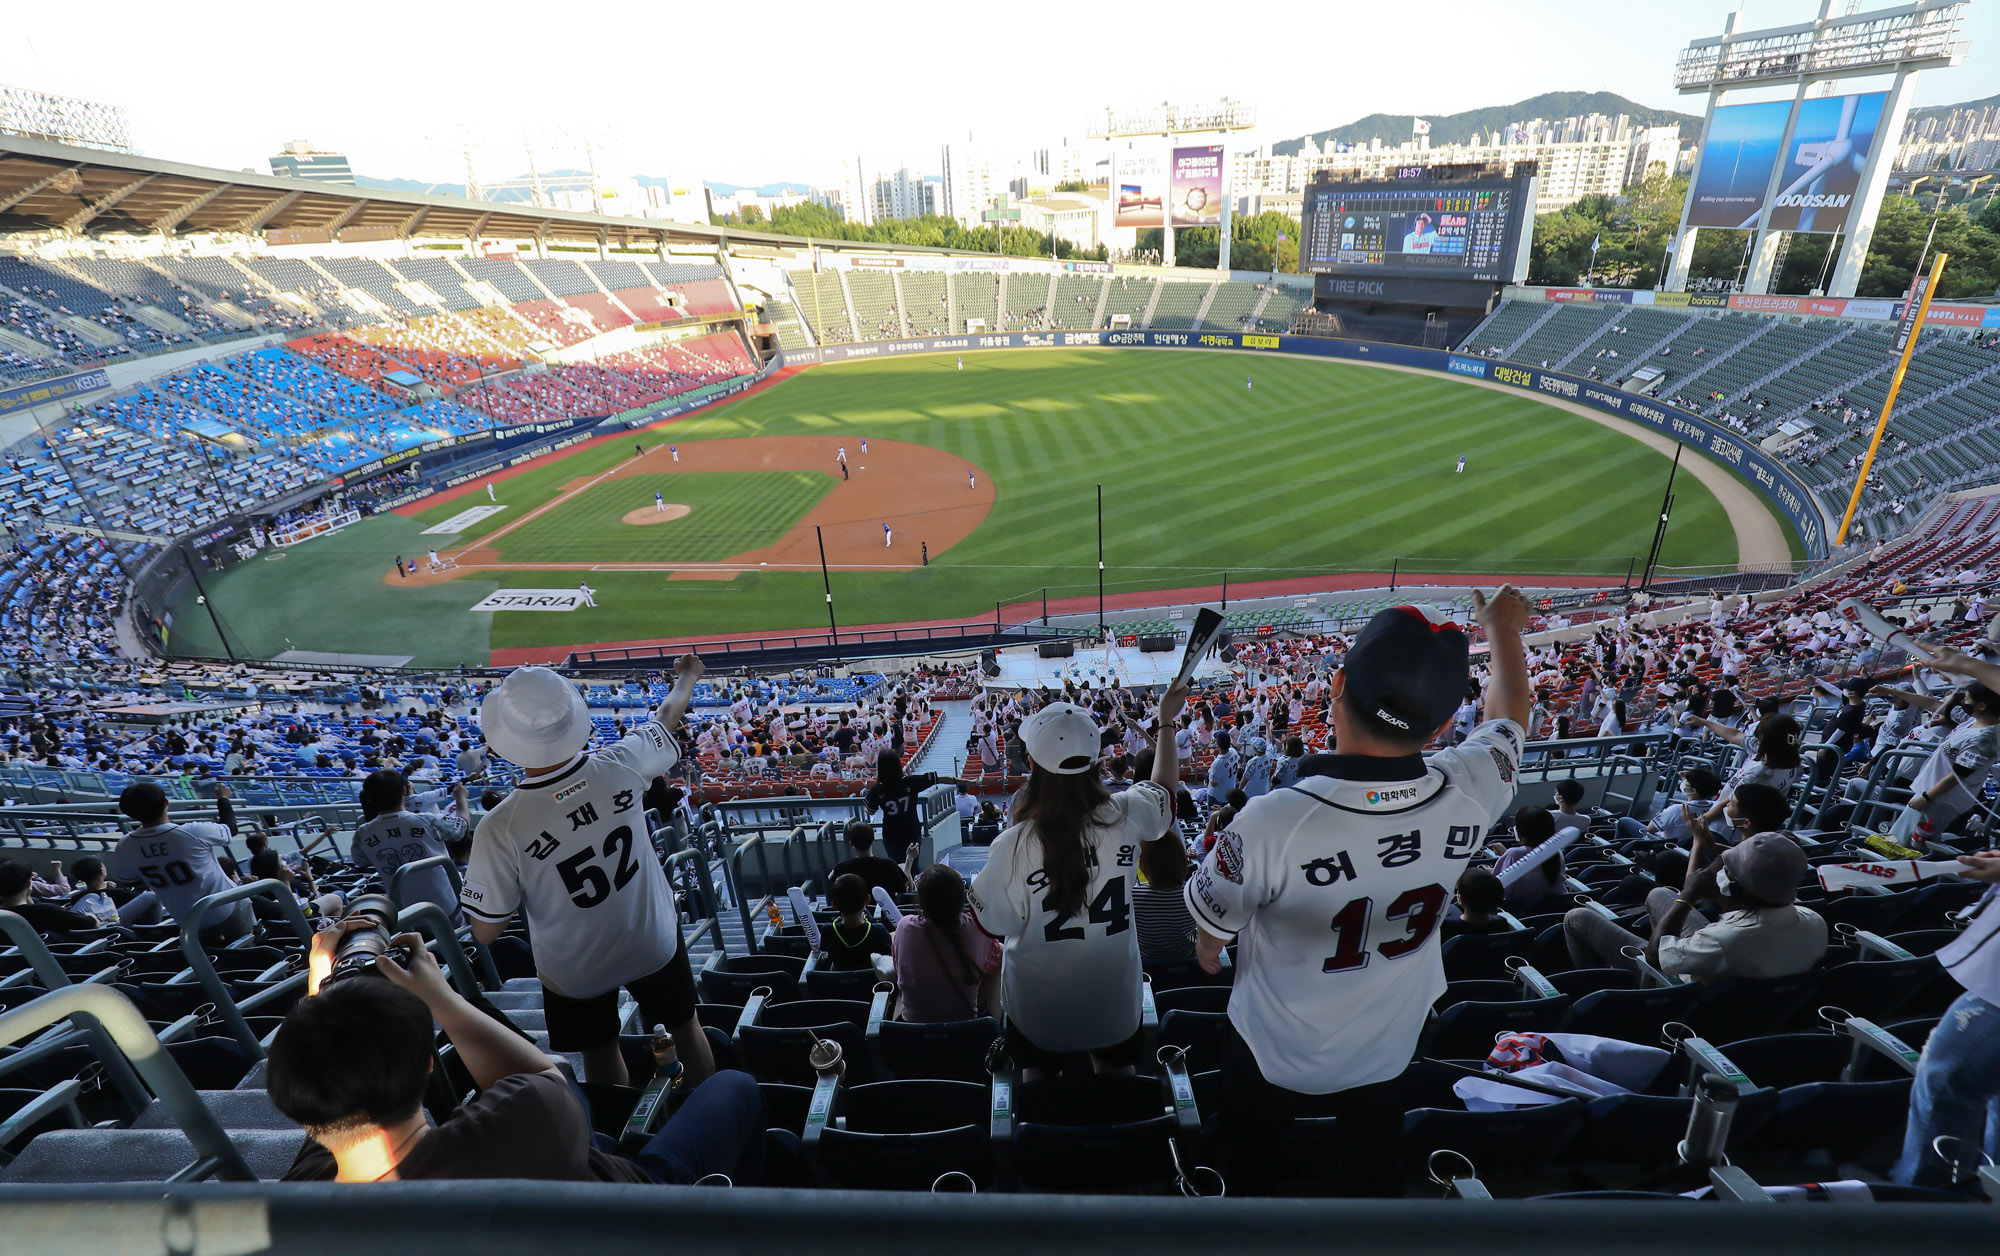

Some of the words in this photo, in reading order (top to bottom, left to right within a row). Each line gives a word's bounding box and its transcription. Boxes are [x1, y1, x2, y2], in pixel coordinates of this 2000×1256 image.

[1398, 168, 1421, 178] 18:57
[1777, 194, 1851, 208] DOOSAN
[1440, 216, 1467, 225] BEARS
[1328, 279, 1355, 293] TIRE
[1357, 281, 1385, 295] PICK
[1736, 296, 1799, 310] 두산인프라코어
[1926, 310, 1955, 320] DOOTA
[1957, 314, 1980, 322] MALL
[979, 336, 1010, 347] 키움증권
[1064, 333, 1100, 345] 금성백조
[1121, 333, 1145, 344] 금강주택
[1153, 334, 1189, 345] 현대해상
[1198, 334, 1234, 347] 서경대학교
[1455, 363, 1485, 375] 도미노피자
[1494, 366, 1532, 386] 대방건설
[1629, 402, 1666, 424] 미래에셋증권
[484, 596, 577, 607] STARIA
[1376, 708, 1410, 730] BEARS
[749, 766, 760, 775] 13
[563, 780, 587, 798] 대화제약
[1380, 786, 1417, 803] 대화제약
[885, 796, 909, 815] 37
[524, 789, 634, 861] 김재호
[365, 827, 426, 848] 김재환
[140, 842, 169, 860] LEE
[1301, 824, 1481, 887] 허경민
[139, 861, 194, 889] 50
[555, 825, 640, 909] 52
[1321, 882, 1449, 974] 13
